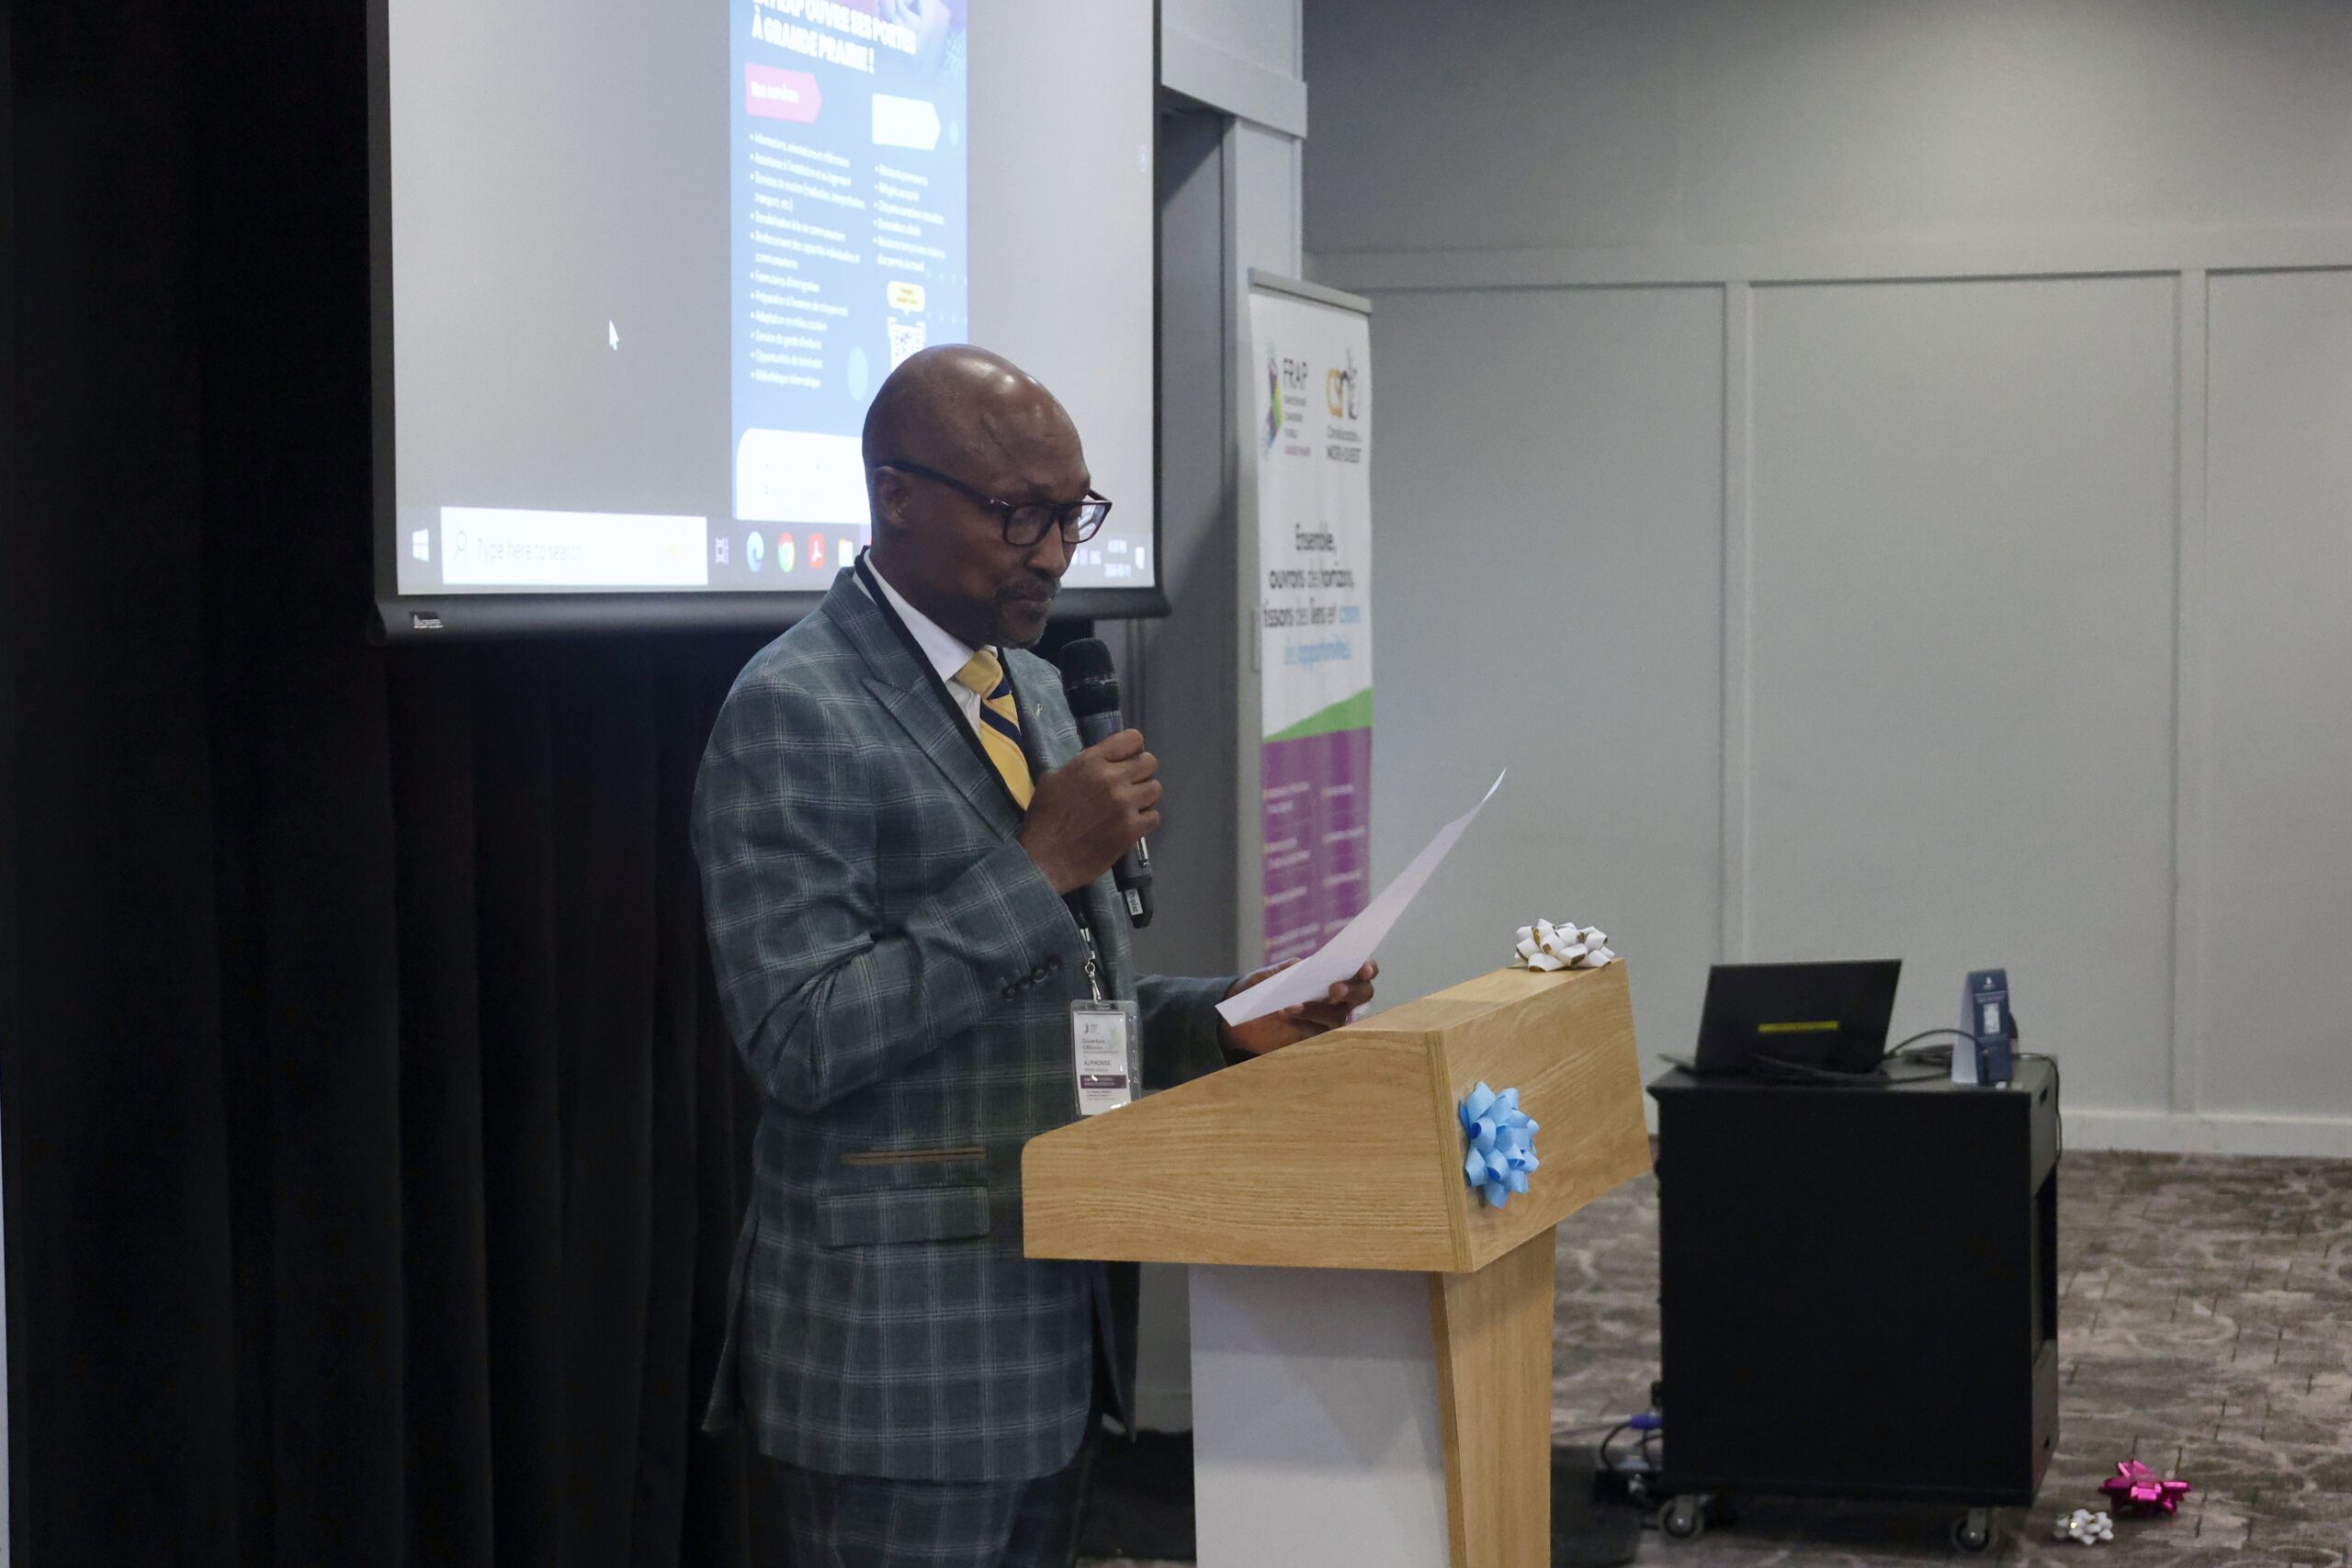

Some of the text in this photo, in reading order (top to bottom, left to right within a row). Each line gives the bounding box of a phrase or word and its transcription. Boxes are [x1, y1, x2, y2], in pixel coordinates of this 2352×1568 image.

[752, 5, 763, 40] À
[763, 17, 818, 59] GRANDE
[818, 33, 868, 73] PRAIRIE
[805, 0, 850, 33] OUVRE
[850, 10, 873, 41] SES
[873, 17, 917, 55] PORTES
[1283, 358, 1308, 391] FRAP
[477, 538, 504, 565] Type
[507, 536, 531, 561] here
[535, 541, 546, 561] to
[1270, 569, 1305, 589] ouvrons
